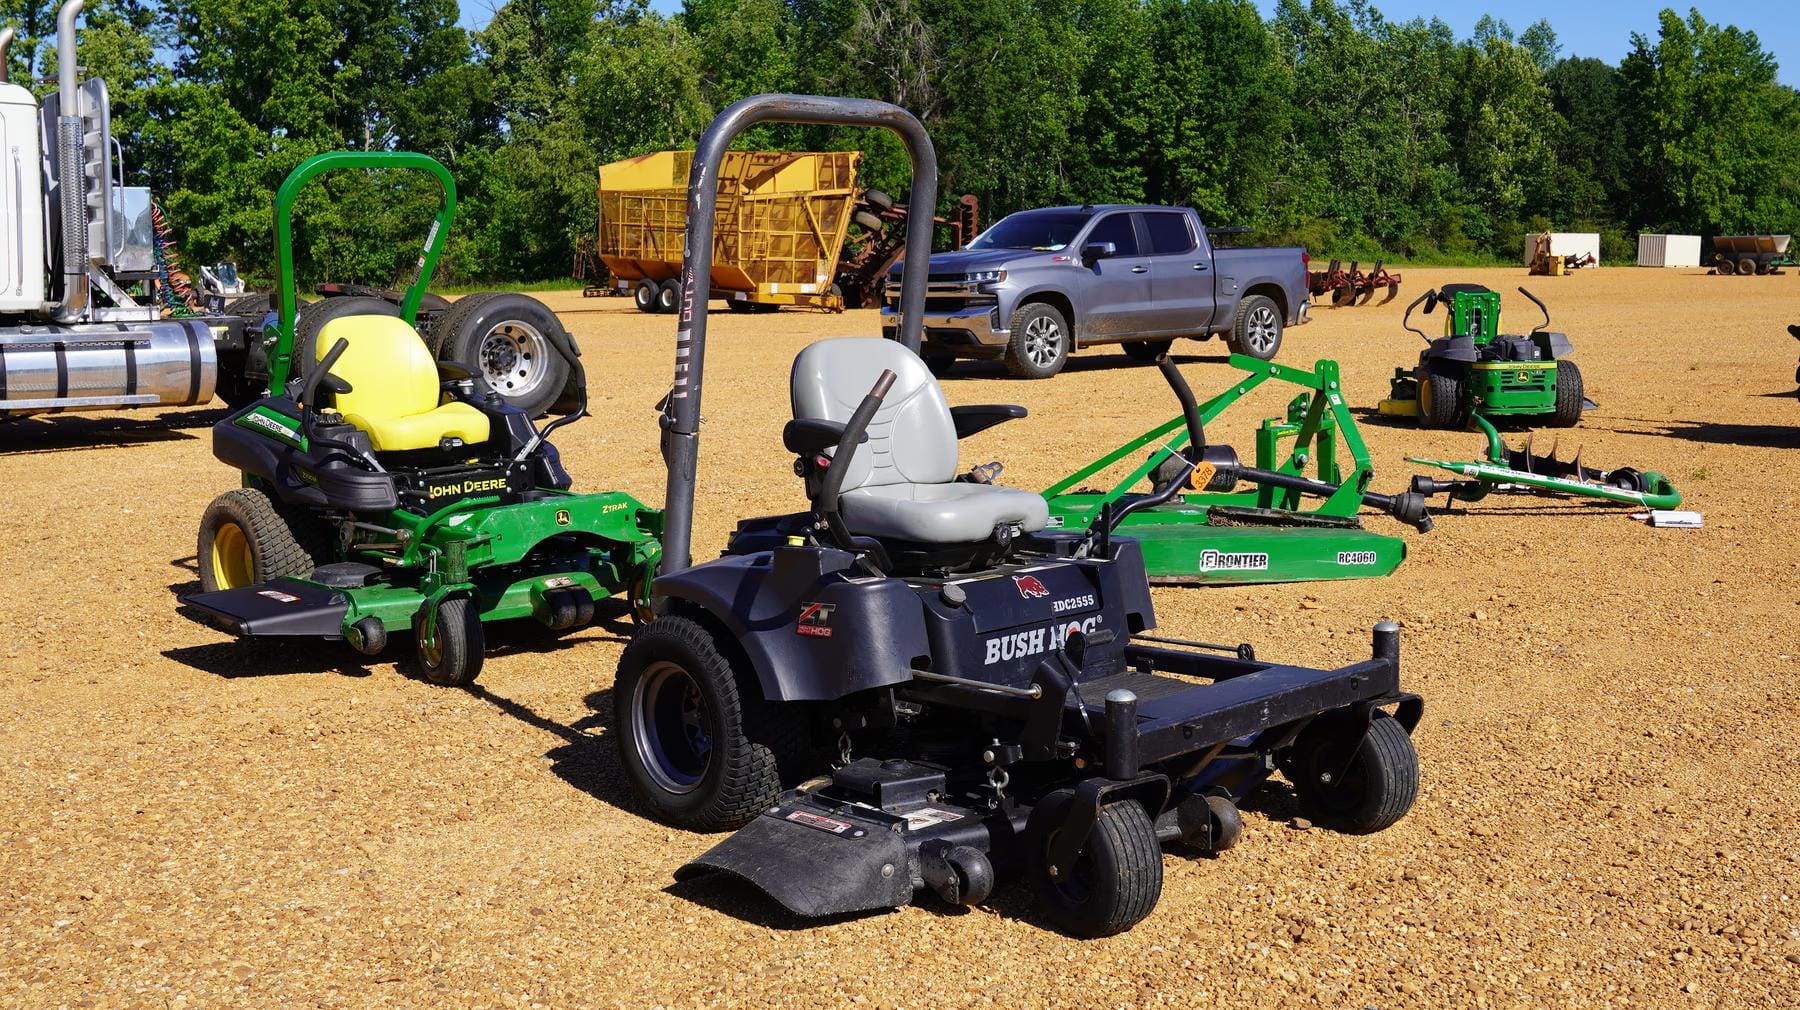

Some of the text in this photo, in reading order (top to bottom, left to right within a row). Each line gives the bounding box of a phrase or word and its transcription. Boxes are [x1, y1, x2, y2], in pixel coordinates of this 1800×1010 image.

[266, 418, 284, 433] DEERE
[1194, 466, 1213, 489] 3378
[429, 478, 507, 498] JOHN DEERE
[1200, 551, 1267, 569] FRONTIER
[1338, 552, 1376, 564] RC4060
[810, 627, 831, 637] HOG
[984, 628, 1045, 665] BUSH
